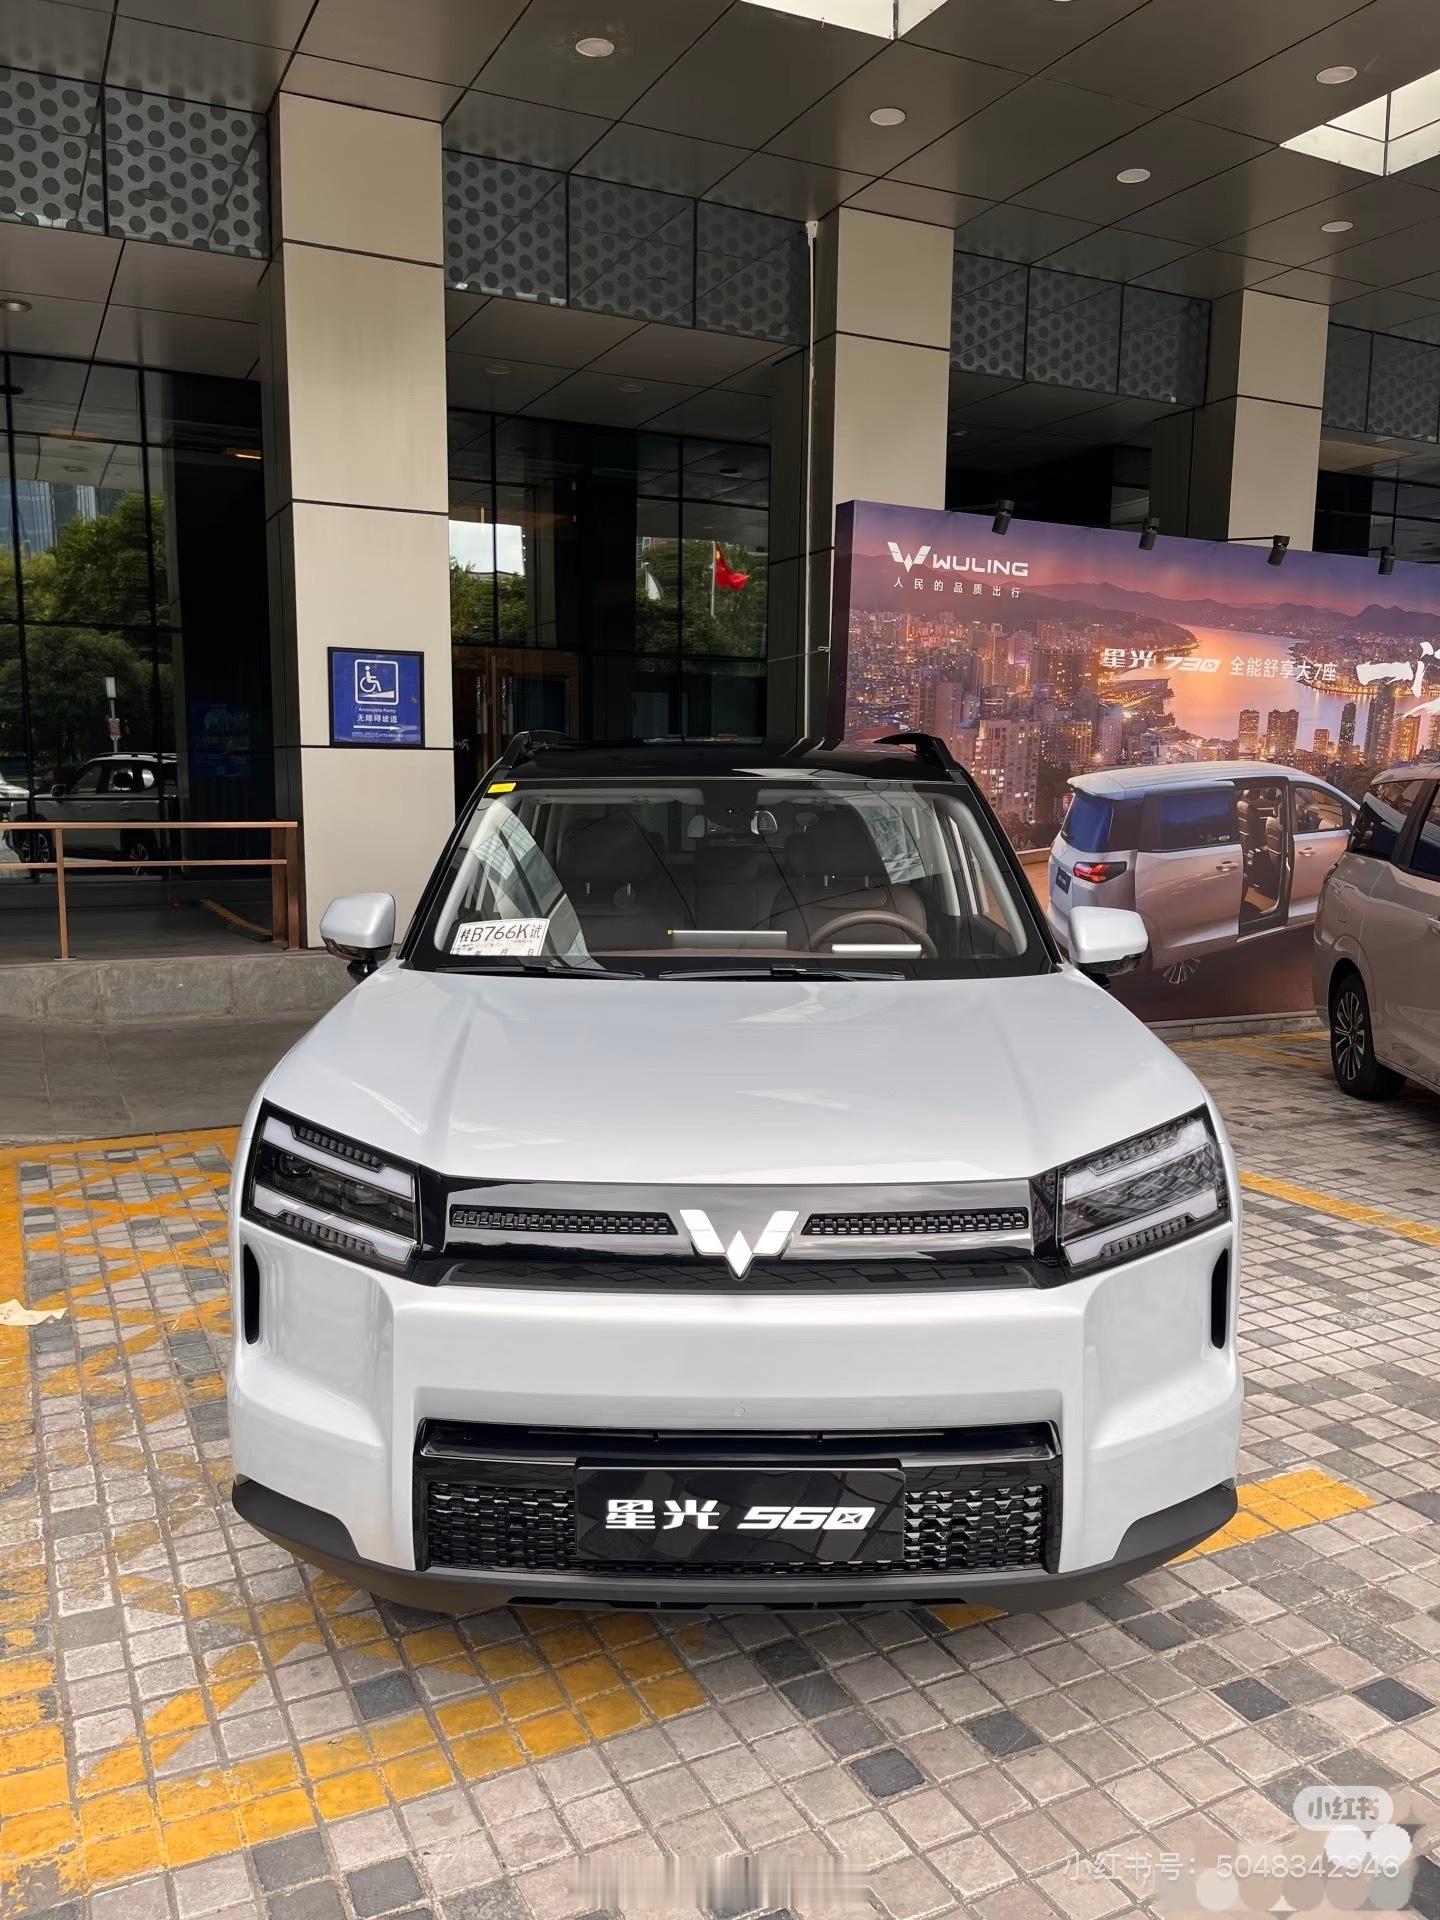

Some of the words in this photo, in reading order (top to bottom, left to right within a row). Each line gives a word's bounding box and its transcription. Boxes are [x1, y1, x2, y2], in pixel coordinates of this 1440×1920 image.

[932, 553, 1029, 577] WULING
[893, 575, 1021, 599] 人民的品质出行
[1102, 647, 1156, 670] 星光
[1162, 656, 1221, 673] 730
[1229, 655, 1338, 683] 全能舒享大7座
[357, 714, 397, 723] 无障碍坡道
[605, 1499, 720, 1530] 星光
[736, 1506, 876, 1530] 560
